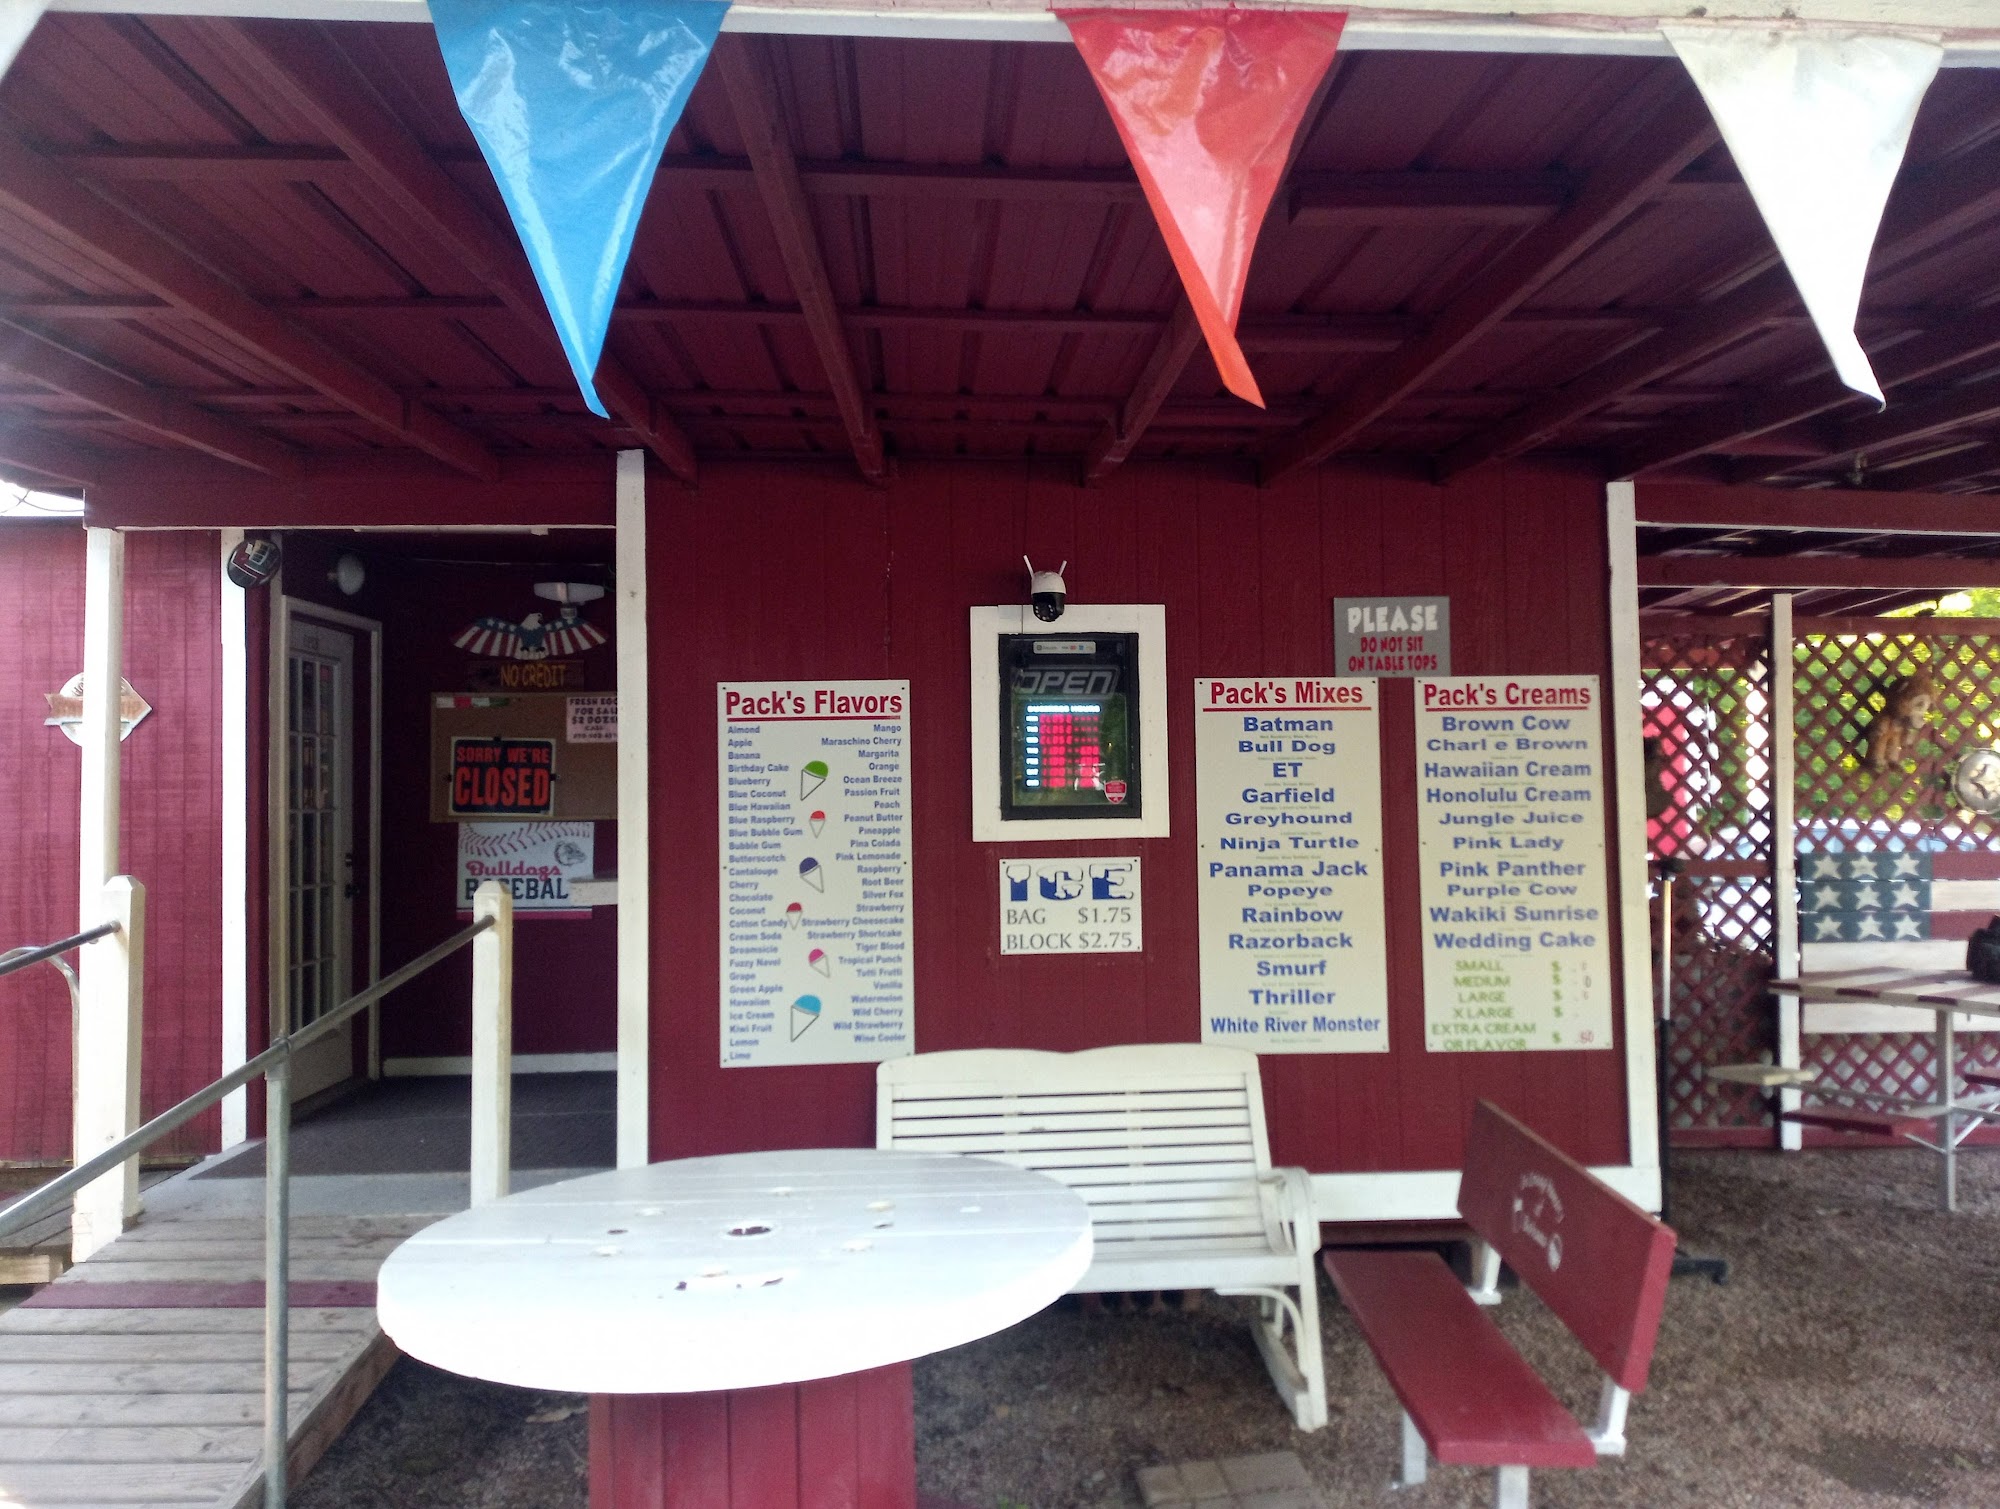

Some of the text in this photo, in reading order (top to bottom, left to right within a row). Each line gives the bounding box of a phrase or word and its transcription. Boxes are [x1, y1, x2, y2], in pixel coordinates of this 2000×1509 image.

[1347, 605, 1437, 633] PLEASE
[1360, 636, 1423, 653] DO NOT SIT
[1348, 655, 1437, 671] ON TABLE TOPS
[502, 664, 566, 687] NO CREDIT
[1016, 671, 1112, 694] OPEN
[1211, 681, 1363, 704] Pack's Mixes
[1424, 682, 1591, 706] Pack's Creams
[726, 690, 902, 715] Pack's Flavors
[873, 724, 901, 733] Mango
[1243, 716, 1333, 732] Batman
[1442, 715, 1570, 732] Brown Cow
[728, 726, 760, 734] Almond
[728, 739, 752, 747] Apple
[873, 737, 901, 746] Cherry
[1239, 740, 1336, 754] Bull Dog
[1516, 738, 1588, 750] Brown
[457, 747, 549, 763] SORRY WE'RE
[858, 750, 899, 759] Margarita
[728, 764, 764, 773] Birthday
[869, 763, 899, 771] Orange
[1273, 762, 1303, 778] ET
[1424, 761, 1591, 778] Hawaiian Cream
[455, 767, 549, 806] CLOSED
[728, 778, 771, 786] Blueberry
[845, 788, 877, 796] Passion
[1242, 788, 1335, 803] Garfield
[1426, 787, 1591, 803] Honolulu Cream
[728, 816, 795, 824] Blue Raspberry
[844, 814, 874, 822] Peanut
[1225, 812, 1352, 827] Greyhound
[1440, 812, 1584, 827] Jungle Juice
[729, 828, 803, 837] Blue Bubble Gum
[859, 827, 901, 835] Pineapple
[1220, 836, 1359, 852] Ninja Turtle
[1453, 837, 1564, 851] Pink Lady
[729, 855, 785, 863] Butterscotch
[465, 860, 561, 881] Bulldogs
[729, 868, 778, 876] Cantaloupe
[857, 865, 902, 874] Raspberry
[1209, 861, 1368, 878] Panama Jack
[1441, 861, 1586, 877] Pink Panther
[729, 881, 759, 890] Cherry
[862, 878, 881, 886] Root
[1006, 863, 1134, 901] ICE
[729, 893, 773, 901] Chocolate
[1248, 884, 1333, 899] Popeye
[1447, 883, 1578, 899] Purple Cow
[729, 907, 765, 915] Coconut
[856, 904, 904, 912] Strawberry
[1430, 906, 1598, 922] Wakiki Sunrise
[1007, 907, 1131, 925] BAG $1.75
[1242, 908, 1343, 923] Rainbow
[729, 920, 787, 928] Cotton Candy
[802, 918, 850, 926] Strawberry
[729, 933, 758, 941] Cream
[807, 930, 902, 939] Strawberry Shortcake
[856, 943, 878, 951] Tiger
[1007, 932, 1132, 950] BLOCK $2.75
[1228, 933, 1352, 950] Razorback
[1434, 932, 1596, 951] Wedding Cake
[839, 957, 873, 965] Tropical
[1455, 961, 1504, 971] SMALL
[1257, 960, 1327, 976] Smurf
[729, 973, 756, 981] Grape
[1454, 977, 1511, 987] MEDIUM
[758, 985, 783, 993] Apple
[851, 995, 903, 1003] Watermelon
[1249, 989, 1336, 1005] Thriller
[1459, 992, 1505, 1002] LARGE
[874, 1008, 903, 1017] Cherry
[1454, 1007, 1514, 1018] X LARGE
[855, 1021, 903, 1030] Strawberry
[1211, 1016, 1380, 1033] White River Monster
[1432, 1023, 1536, 1035] EXTRA CREAM
[1444, 1039, 1526, 1050] OR FLAVOR
